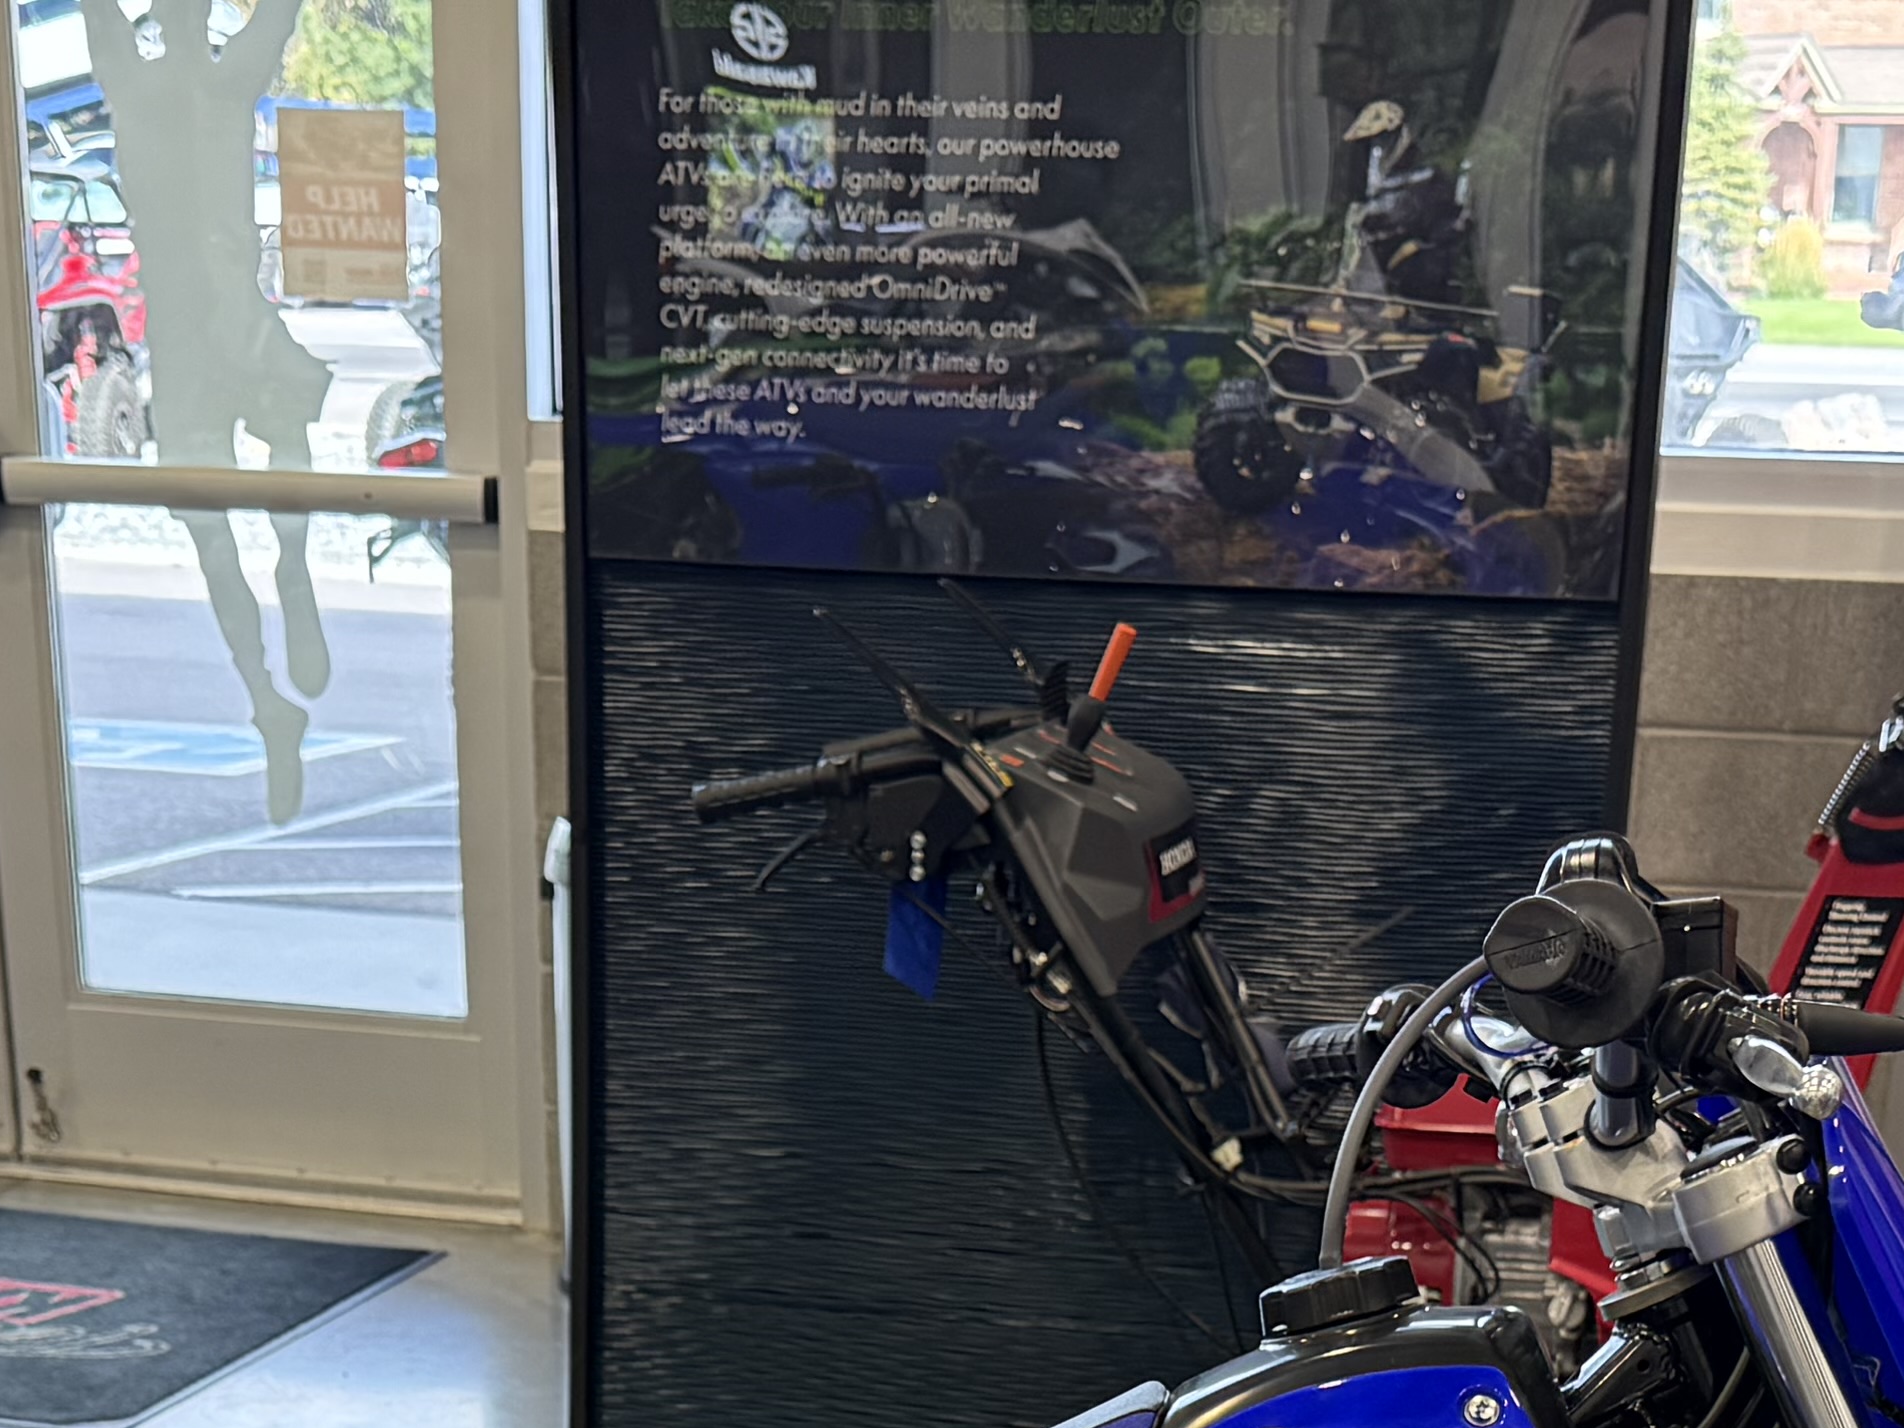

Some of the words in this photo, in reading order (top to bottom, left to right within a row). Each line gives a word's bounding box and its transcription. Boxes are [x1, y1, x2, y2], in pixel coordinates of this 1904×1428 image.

[658, 87, 694, 114] For
[699, 87, 760, 115] those
[815, 90, 867, 117] mud
[870, 92, 893, 118] in
[897, 91, 947, 119] their
[951, 95, 1010, 120] veins
[1013, 93, 1064, 121] and
[657, 125, 772, 151] adventure
[856, 127, 930, 157] hearts,
[937, 136, 978, 157] our
[978, 129, 1122, 163] powerhouse
[657, 160, 710, 187] ATVs
[841, 166, 906, 197] ignite
[909, 171, 961, 199] your
[963, 167, 1041, 199] primal
[657, 204, 707, 230] urge
[835, 200, 890, 226] With
[927, 202, 1017, 230] all-new
[658, 236, 760, 265] platform,
[796, 245, 850, 263] even
[854, 244, 914, 264] more
[915, 238, 1020, 271] powerful
[658, 274, 740, 301] engine,
[743, 270, 869, 305] redesigned
[712, 307, 858, 341] cutting-edge
[859, 314, 986, 342] suspension,
[989, 312, 1039, 340] and
[659, 344, 760, 374] next-gen
[761, 346, 896, 378] connectivity
[931, 349, 983, 374] time
[985, 350, 1010, 375] to
[660, 373, 690, 399] let
[752, 377, 808, 402] ATVs
[810, 379, 858, 405] and
[859, 388, 911, 413] your
[912, 383, 1042, 412] wanderlust
[660, 406, 713, 435] lead
[714, 407, 752, 436] the
[753, 420, 807, 445] way.
